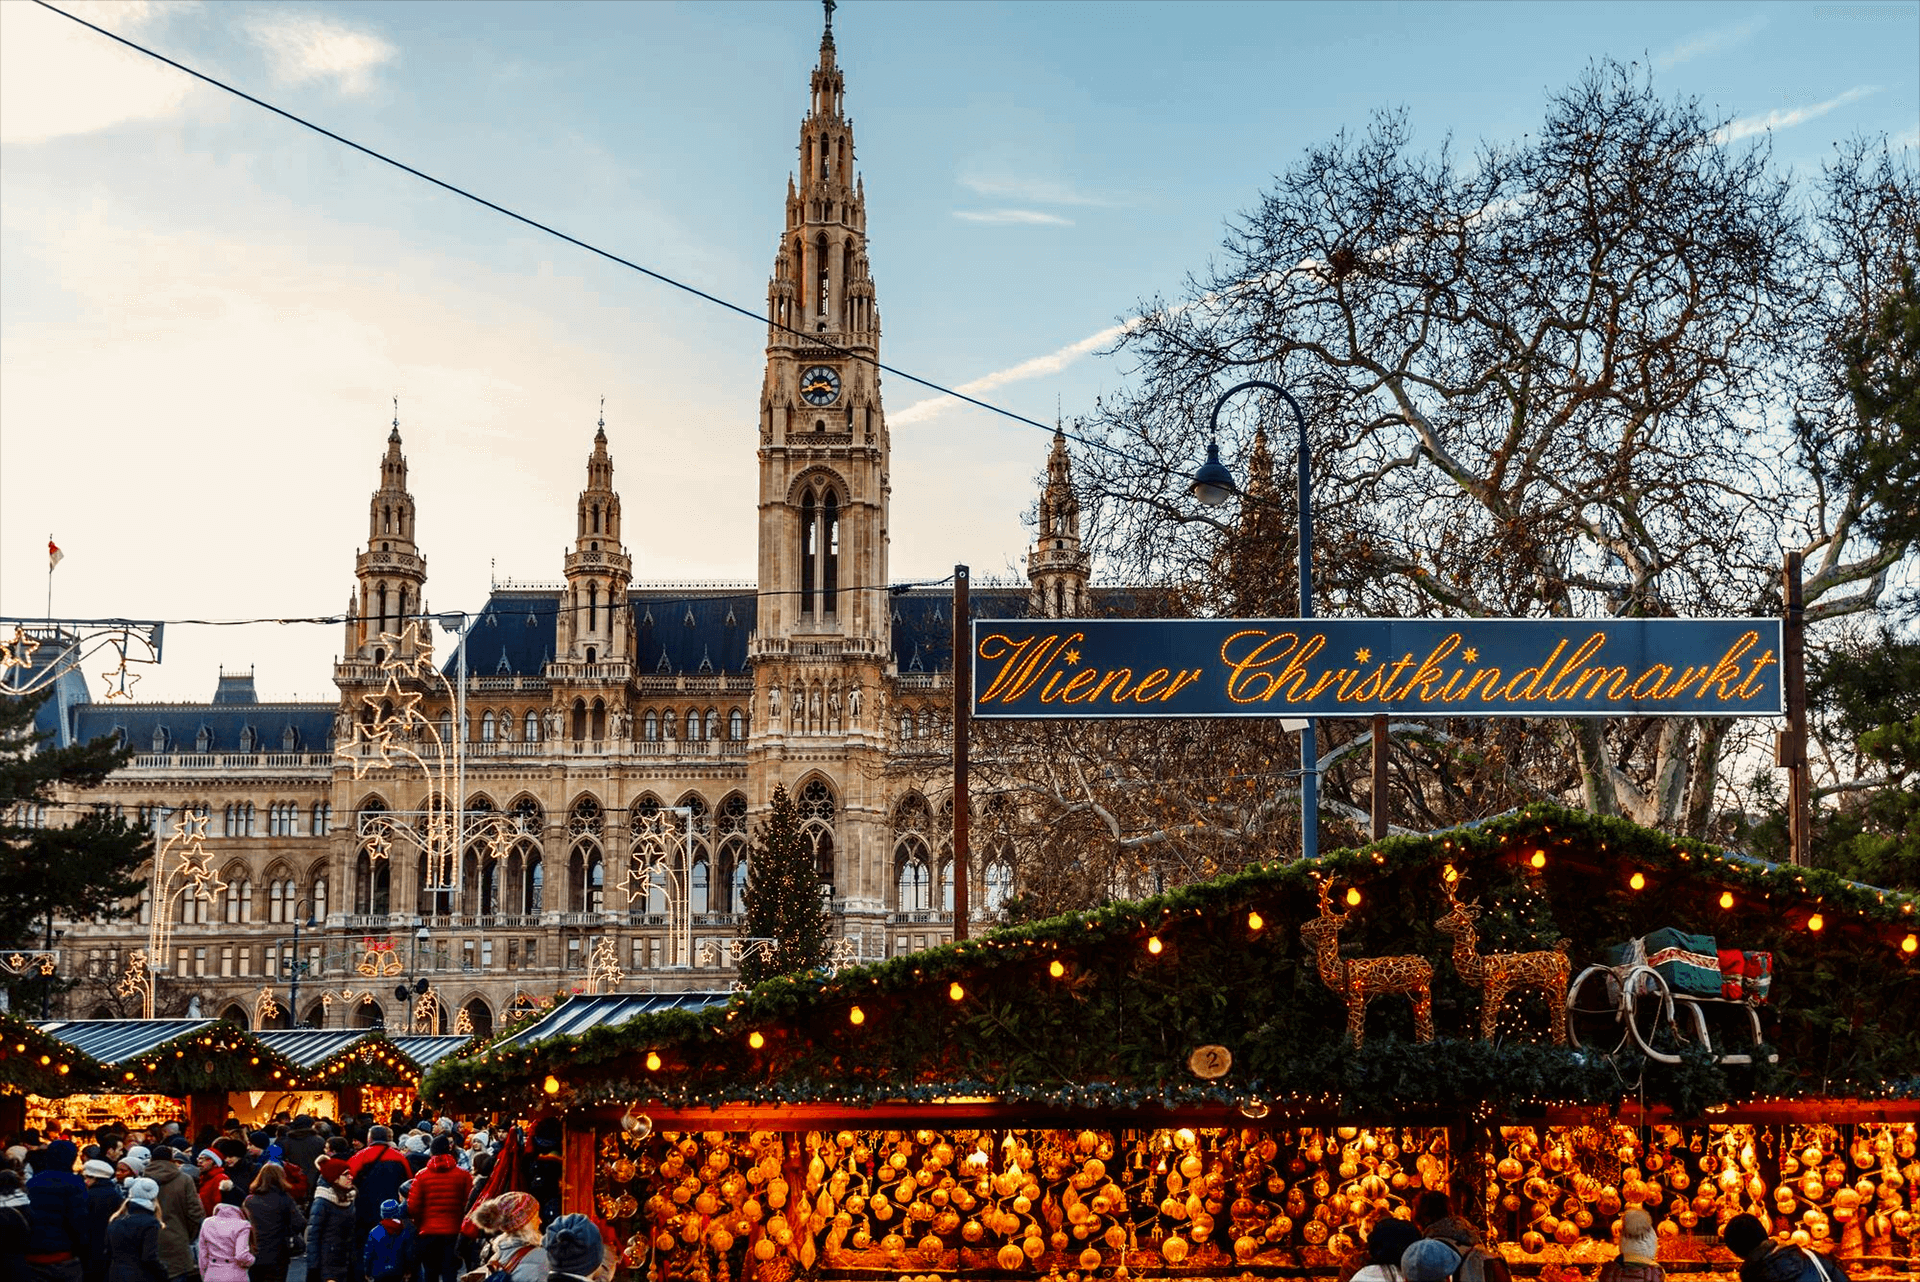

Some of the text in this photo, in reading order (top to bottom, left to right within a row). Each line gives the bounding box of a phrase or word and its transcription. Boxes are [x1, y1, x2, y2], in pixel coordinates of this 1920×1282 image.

[978, 630, 1777, 703] Wiener Christkindlmarkt
[1206, 1051, 1219, 1069] 2
